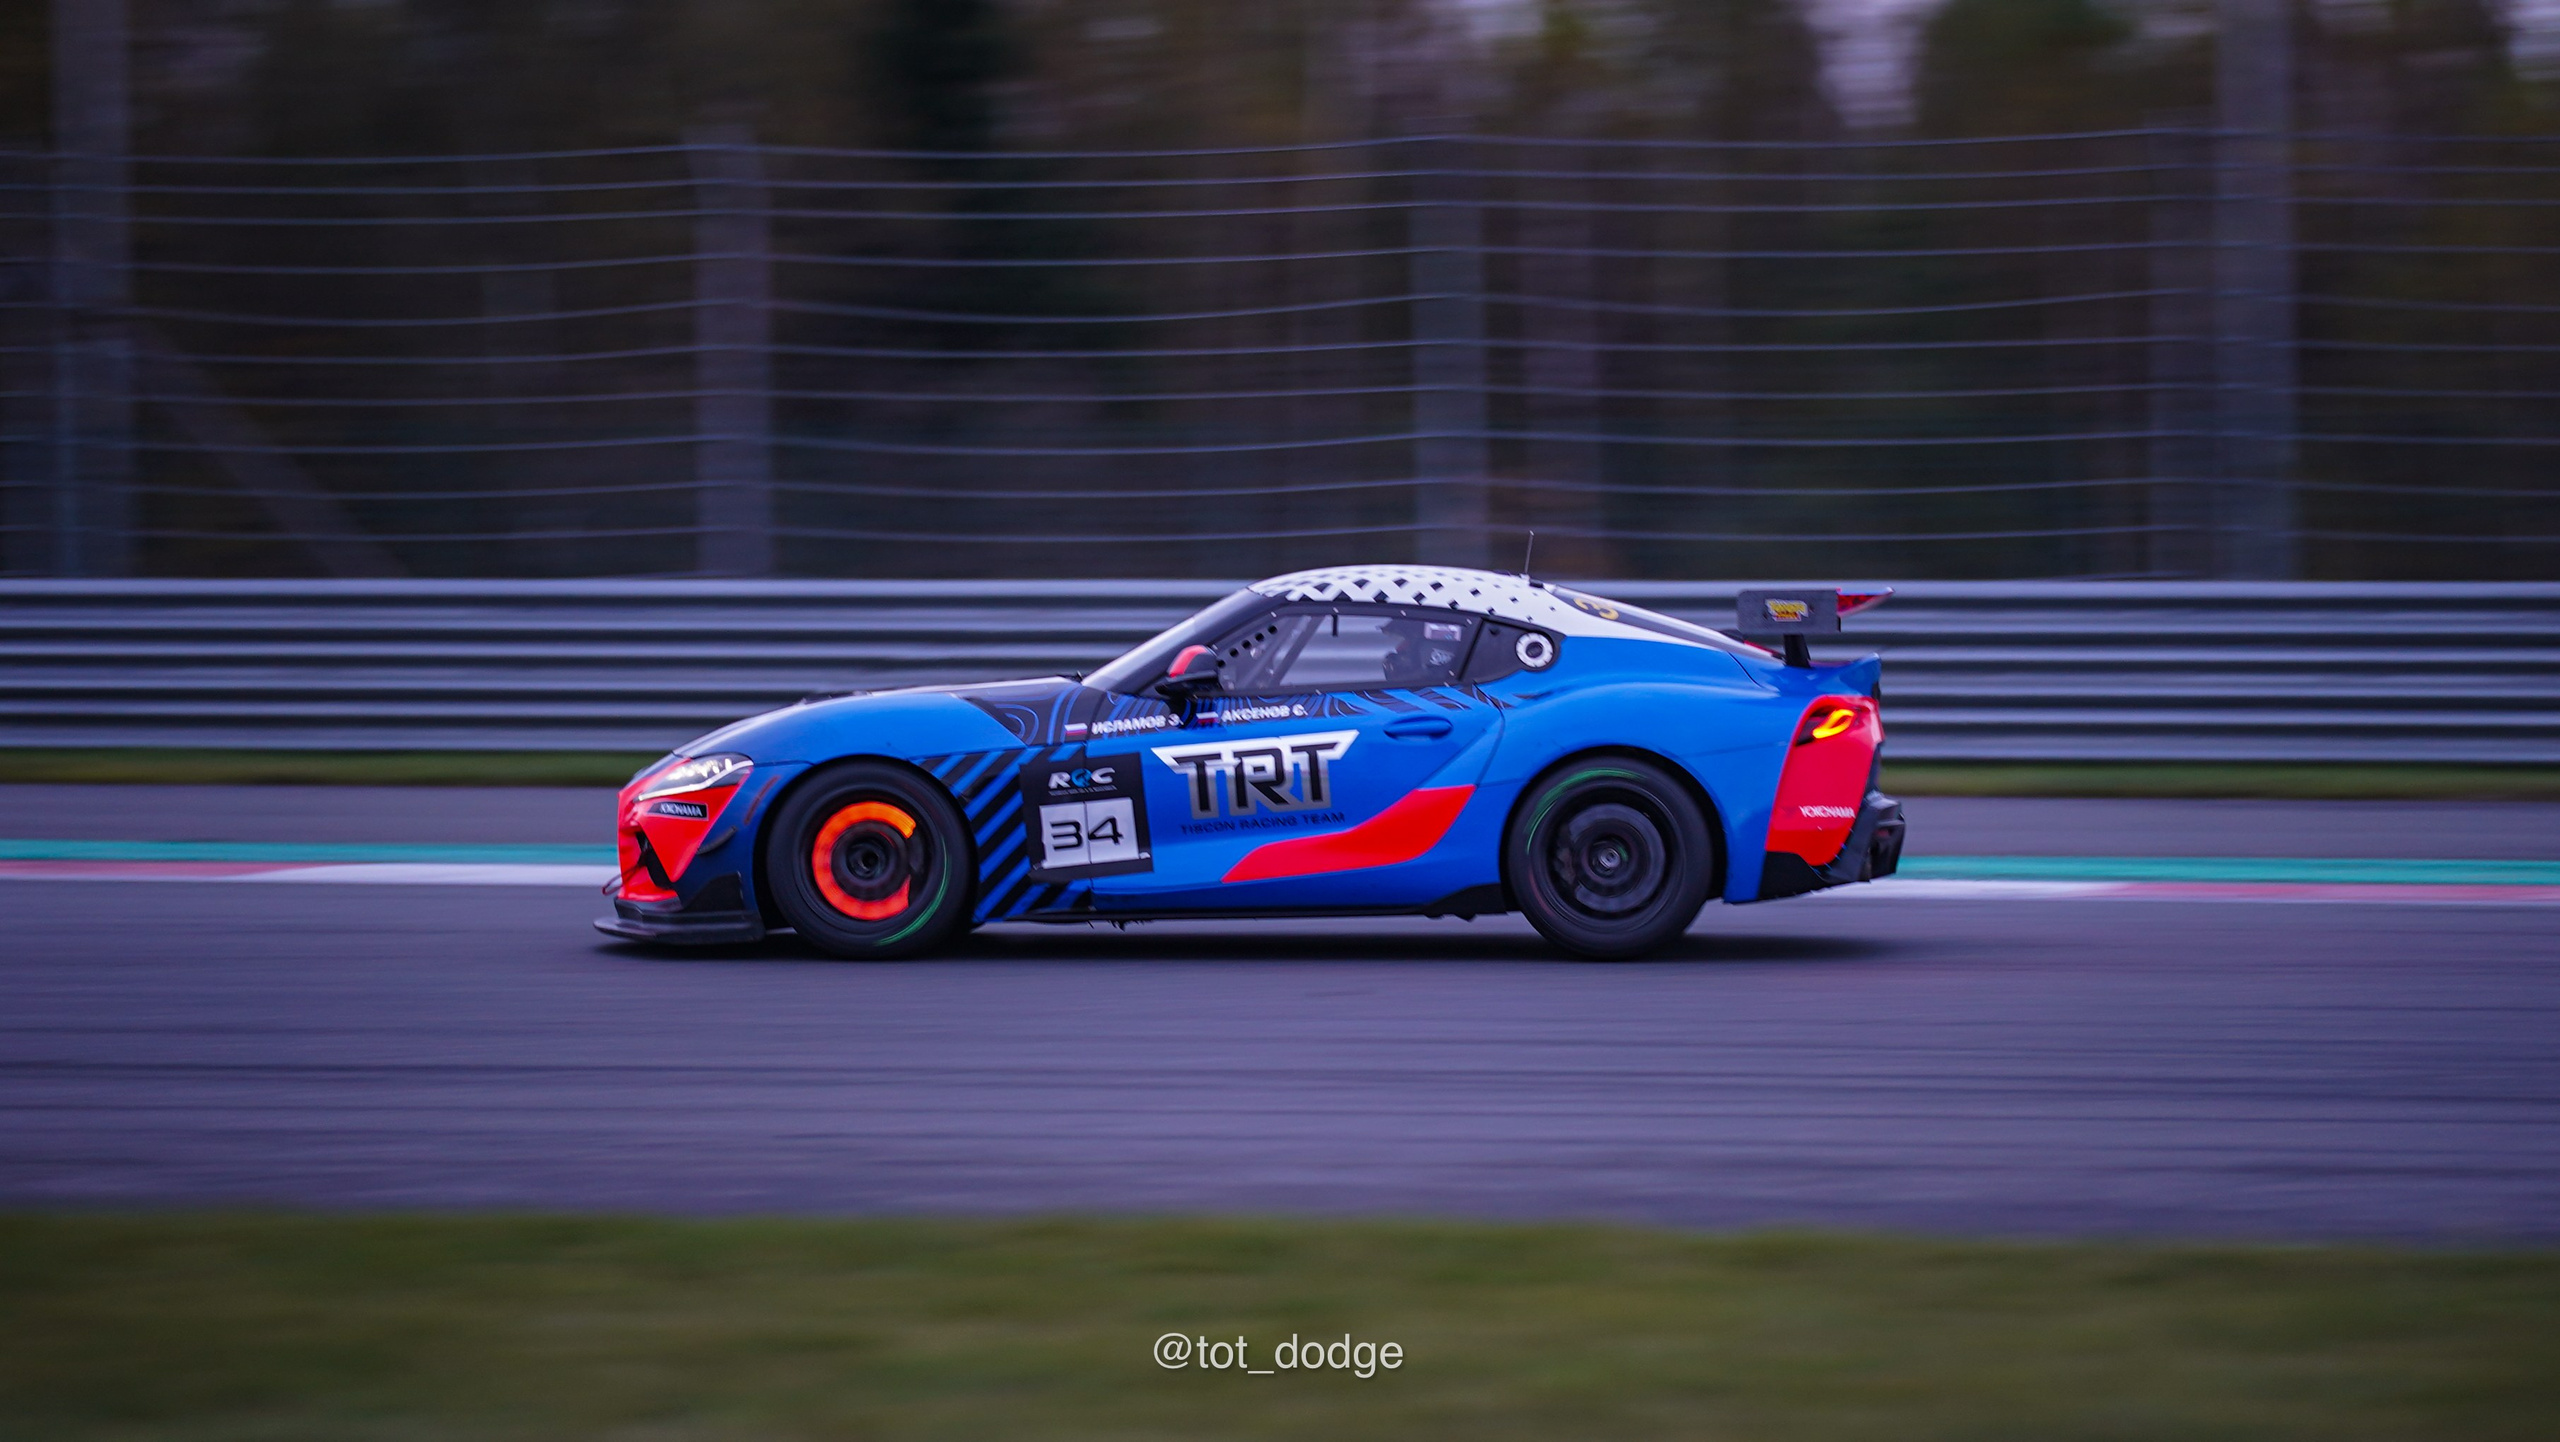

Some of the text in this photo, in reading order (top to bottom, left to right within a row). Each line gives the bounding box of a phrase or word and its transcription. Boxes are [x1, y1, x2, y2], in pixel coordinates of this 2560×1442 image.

[1151, 729, 1360, 819] TRT
[1050, 815, 1124, 851] 34
[1238, 815, 1298, 830] RACING
[1302, 811, 1346, 825] TEAM
